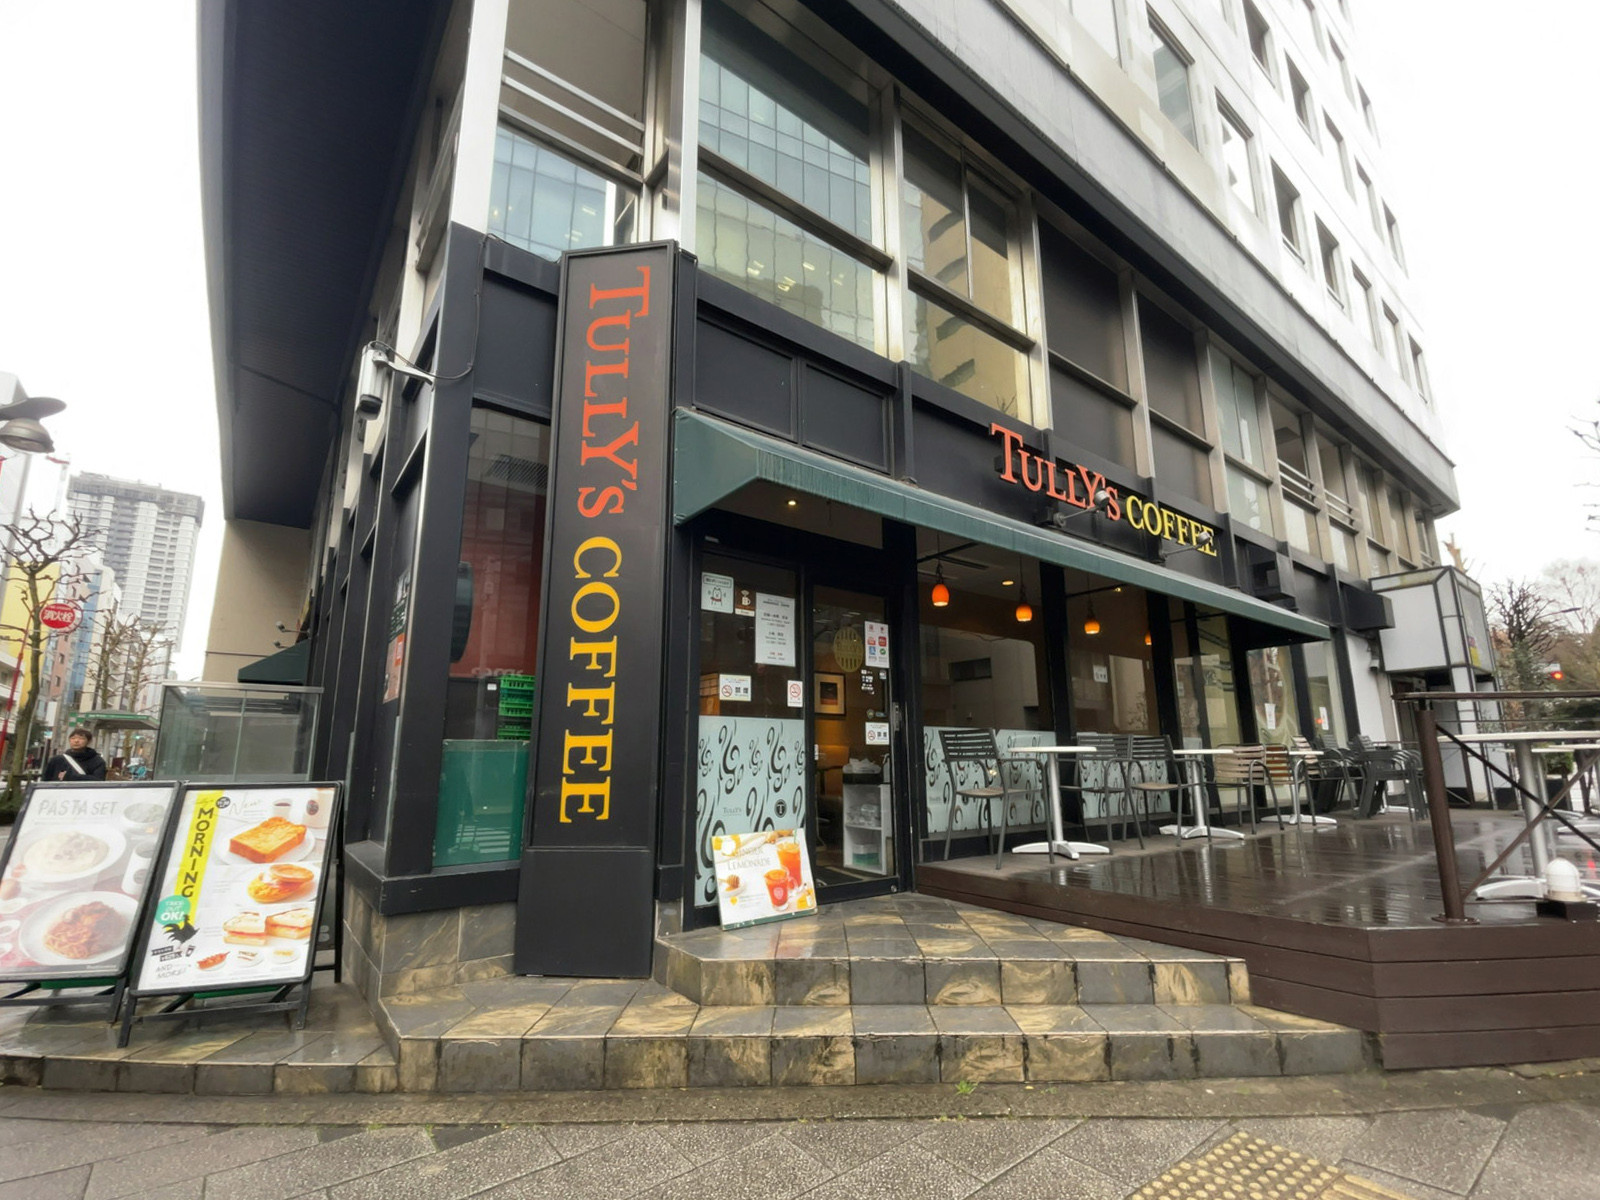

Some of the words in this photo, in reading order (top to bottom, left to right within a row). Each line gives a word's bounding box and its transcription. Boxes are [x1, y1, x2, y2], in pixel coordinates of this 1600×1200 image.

[1126, 495, 1217, 557] COFFEE
[43, 610, 74, 623] 消火栓
[559, 536, 622, 823] COFFEE
[39, 799, 88, 816] PASTA
[91, 801, 120, 816] SET
[181, 807, 214, 898] MORNING
